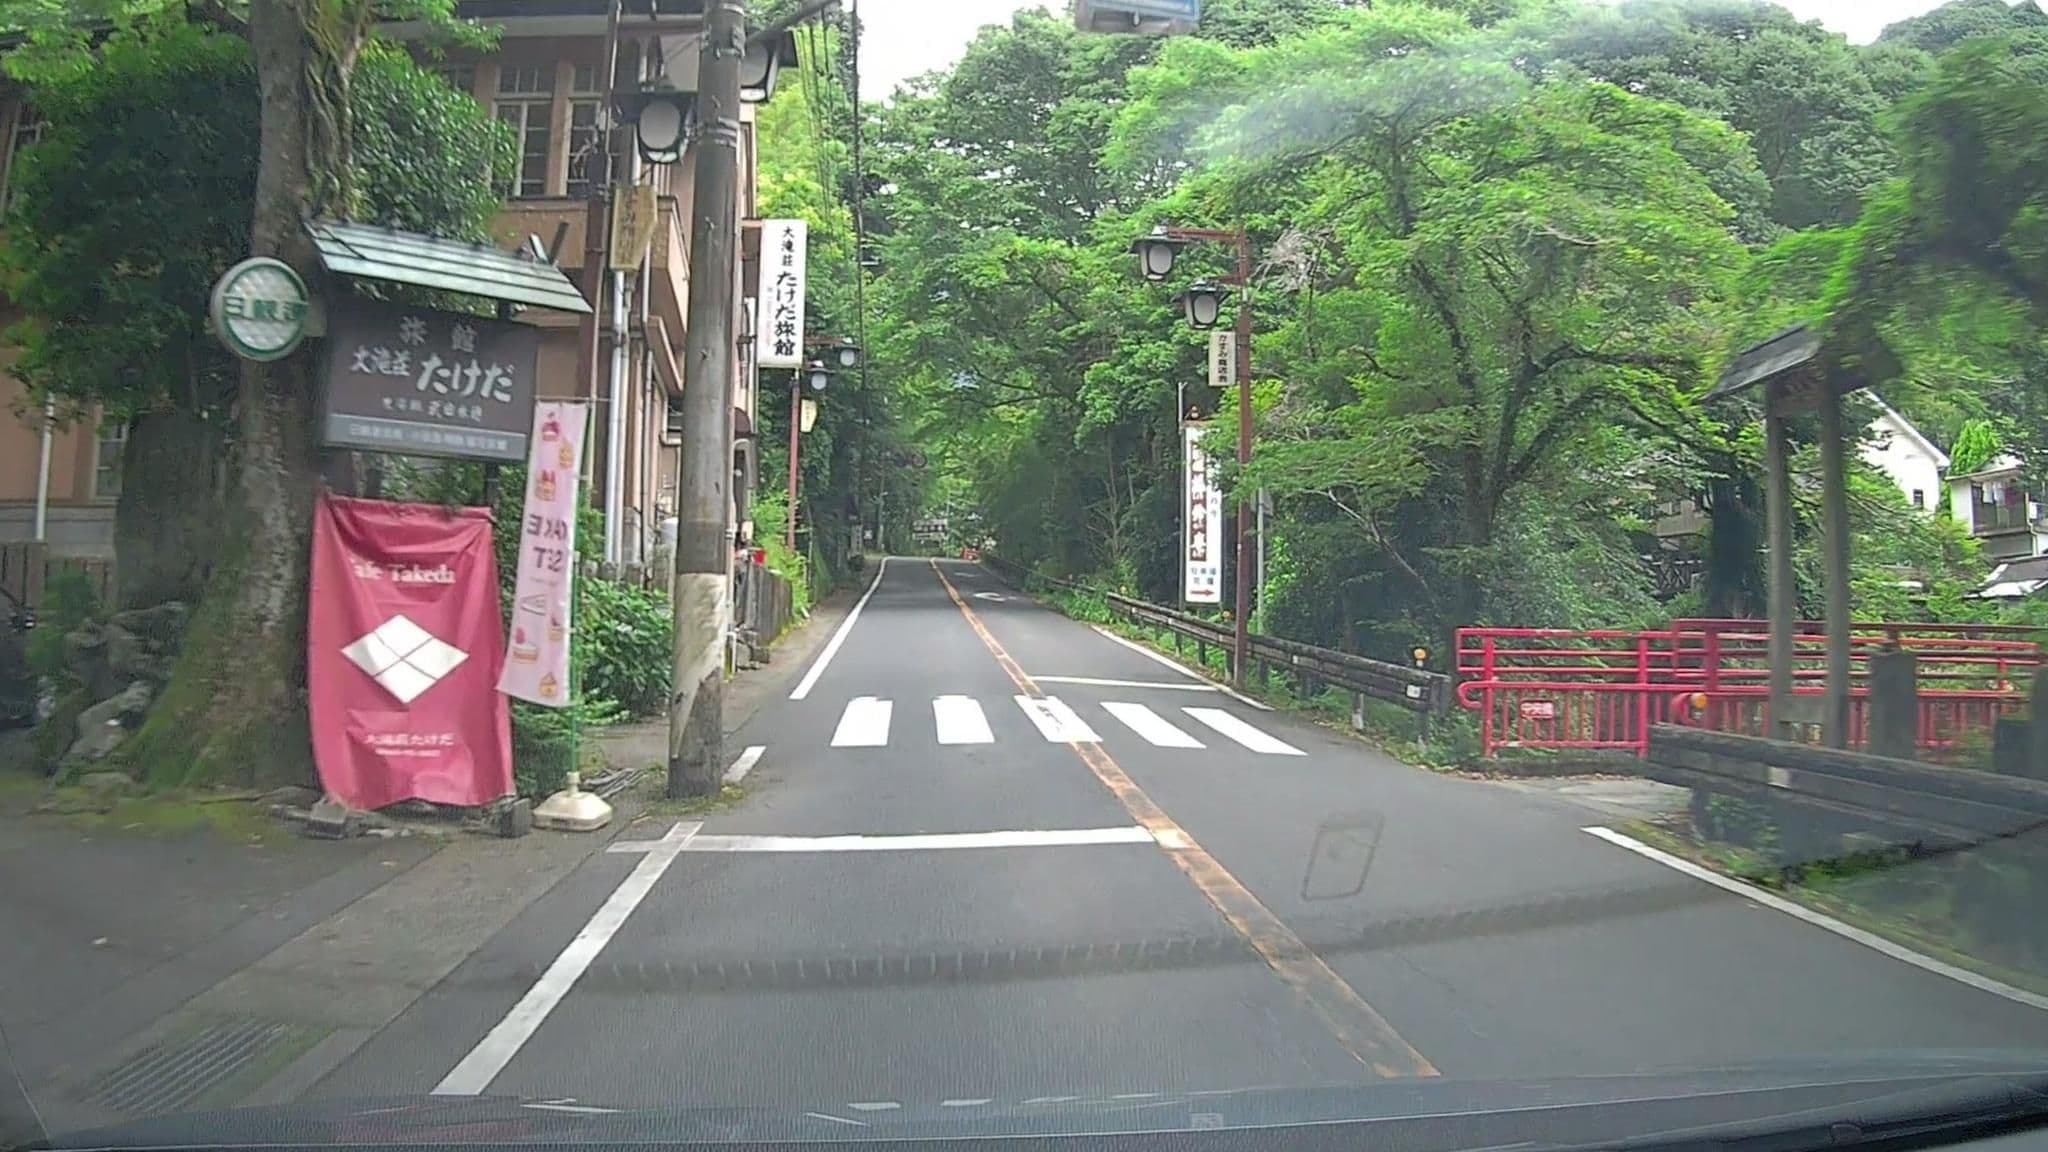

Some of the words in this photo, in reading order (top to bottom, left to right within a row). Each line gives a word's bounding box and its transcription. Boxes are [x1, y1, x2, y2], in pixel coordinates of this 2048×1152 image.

[416, 353, 514, 403] たけだ
[388, 562, 456, 584] Takeda
